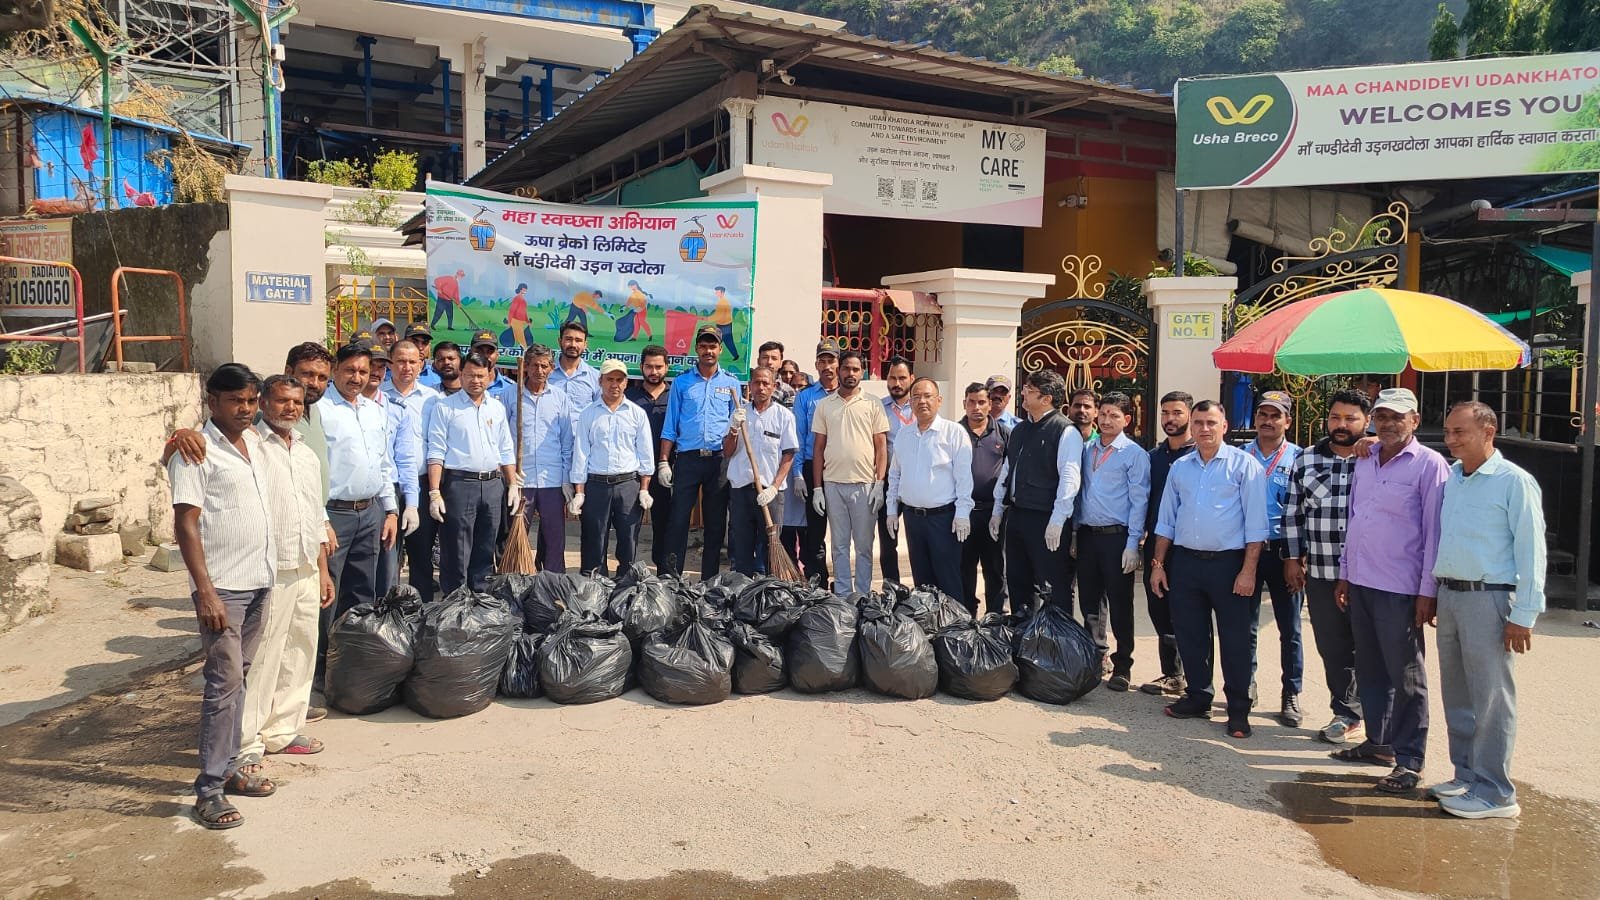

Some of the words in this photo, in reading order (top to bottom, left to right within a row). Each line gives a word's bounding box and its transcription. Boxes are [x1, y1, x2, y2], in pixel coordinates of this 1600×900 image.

[1307, 83, 1348, 97] MAA
[1355, 76, 1469, 94] CHANDIDEVI
[1340, 99, 1511, 125] WELCOMES
[1519, 94, 1582, 115] YOU
[869, 114, 887, 122] UDAN
[888, 115, 915, 125] KHATOLA
[915, 119, 943, 128] ROPEWAY
[851, 120, 887, 130] COMMITTED
[888, 124, 917, 134] TOWARDS
[942, 131, 966, 139] HYGIENE
[891, 133, 905, 141] SAFE
[906, 135, 948, 145] ENVIRONMENT
[982, 129, 1007, 150] MY
[1193, 133, 1230, 145] Usha
[1233, 131, 1279, 143] Breco
[1297, 140, 1313, 156] माँ
[1315, 137, 1362, 156] चण्डीदेवी
[1365, 136, 1430, 156] उड़नखटोला
[1433, 136, 1474, 151] आपका
[1477, 130, 1515, 148] हार्दिक
[1518, 131, 1557, 145] स्वागत
[1561, 129, 1597, 142] करता
[981, 156, 1019, 177] CARE
[502, 209, 537, 225] महा
[541, 213, 604, 229] स्वच्छता
[608, 211, 677, 231] अभियान
[524, 235, 554, 248] ऊषा
[558, 233, 588, 250] ब्रेको
[593, 235, 647, 254] लिमिटेड
[503, 250, 522, 267] माँ
[523, 253, 576, 270] चंडीदेवी
[580, 260, 613, 275] उड़न
[617, 259, 665, 275] खटोला
[32, 266, 70, 278] RADIATION
[252, 275, 308, 288] MATERIAL
[265, 288, 295, 299] GATE
[1173, 314, 1210, 324] GATE
[1173, 327, 1197, 336] NO.
[1202, 327, 1208, 336] 1
[592, 349, 605, 361] में
